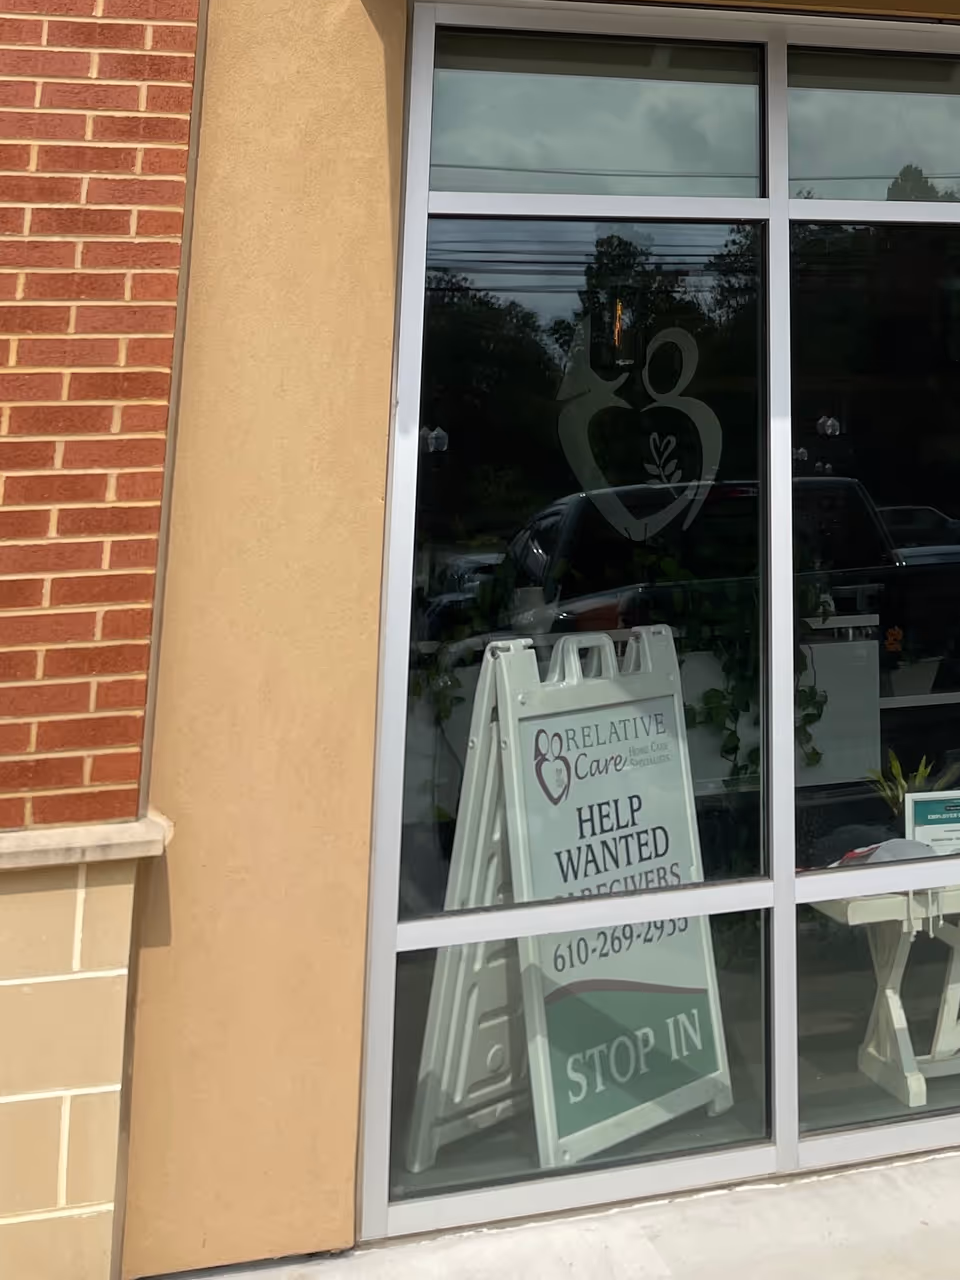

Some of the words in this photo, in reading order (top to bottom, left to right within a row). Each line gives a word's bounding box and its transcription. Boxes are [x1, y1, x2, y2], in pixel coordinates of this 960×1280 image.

[564, 712, 667, 753] RELATIVE
[574, 752, 628, 781] Care
[576, 793, 643, 840] HELP
[555, 825, 670, 885] WANTED
[554, 862, 682, 898] GIVERS
[566, 1026, 656, 1105] STOP
[665, 1008, 703, 1061] IN
